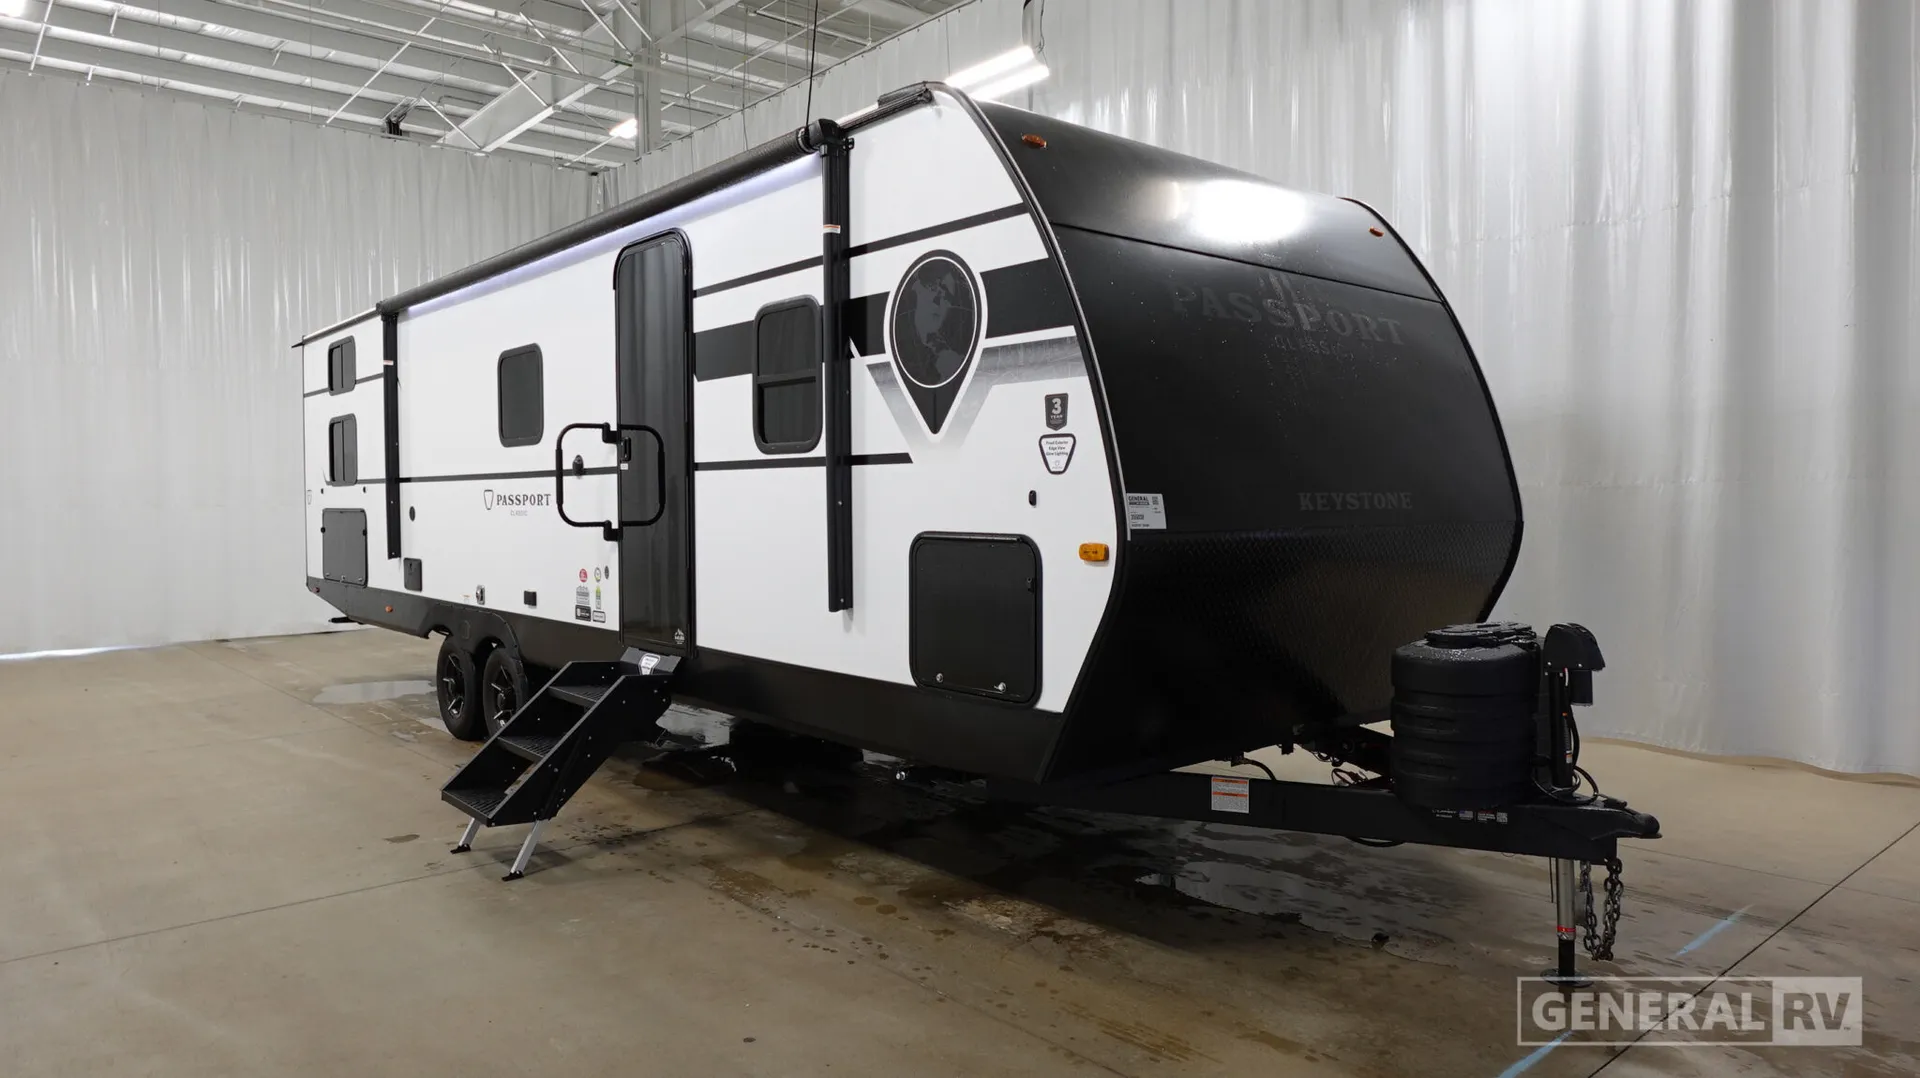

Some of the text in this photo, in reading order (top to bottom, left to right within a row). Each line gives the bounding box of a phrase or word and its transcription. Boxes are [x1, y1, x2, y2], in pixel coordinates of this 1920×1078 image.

[1171, 283, 1403, 345] PASSPORT
[1051, 397, 1062, 415] 3
[496, 494, 551, 506] PASSPORT
[1297, 491, 1413, 511] KEYSTONE
